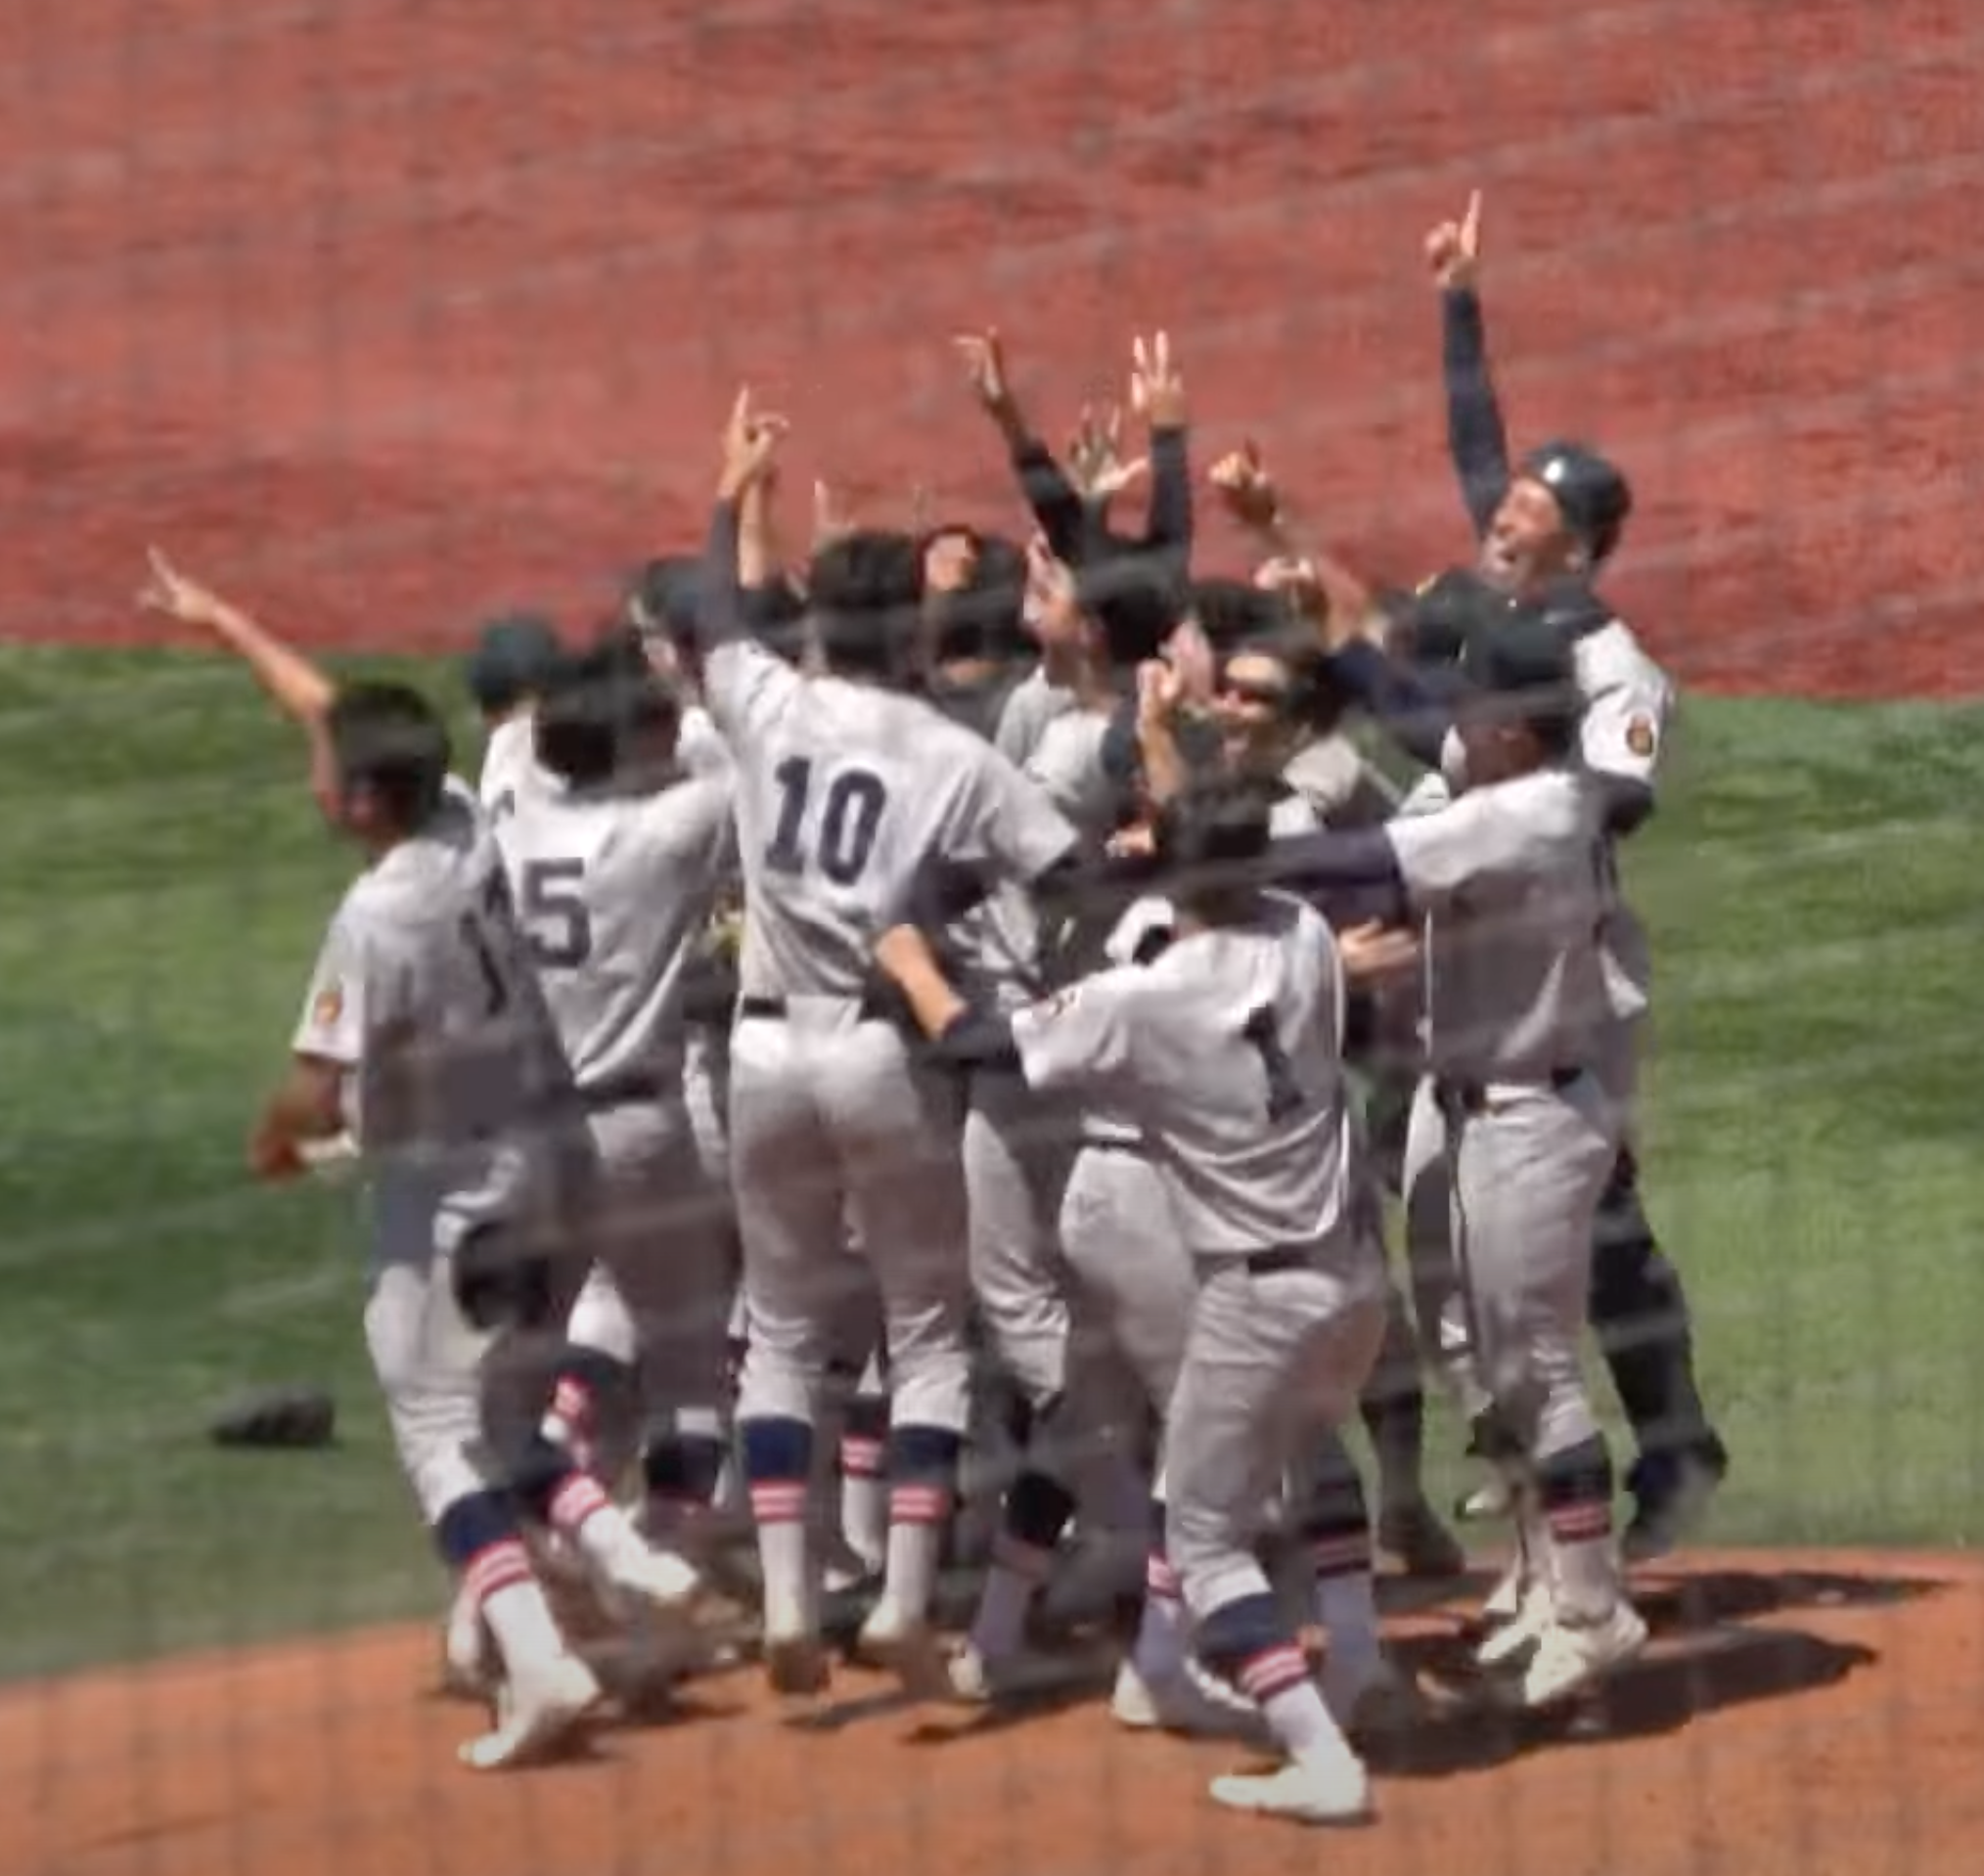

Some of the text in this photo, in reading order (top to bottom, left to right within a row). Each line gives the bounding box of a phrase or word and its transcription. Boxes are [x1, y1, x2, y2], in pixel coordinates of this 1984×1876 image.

[765, 755, 886, 887] 10
[522, 857, 591, 967] 5
[1241, 1002, 1303, 1124] 1
